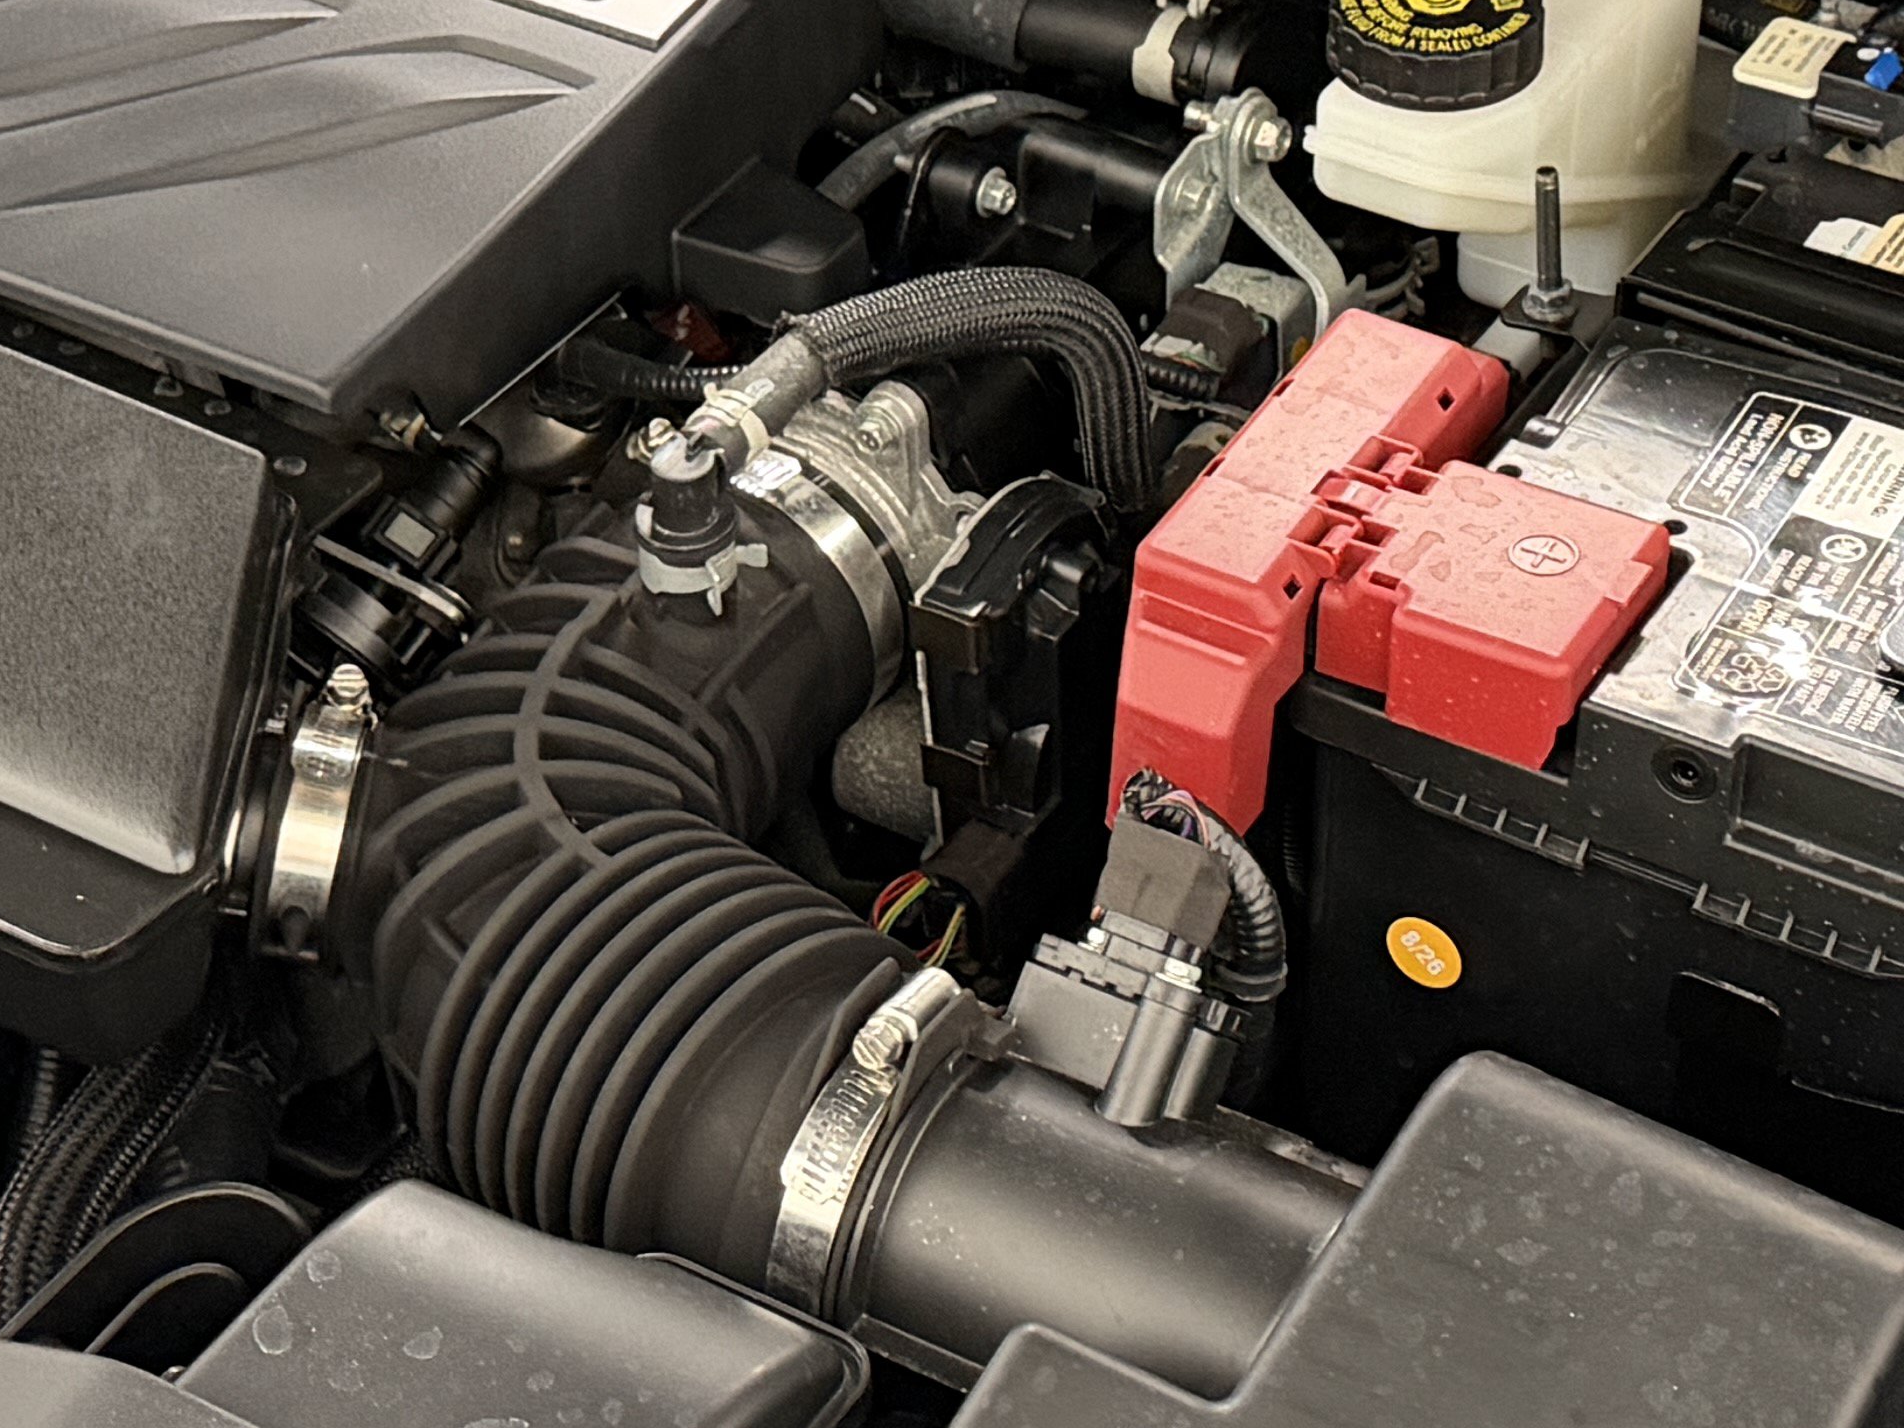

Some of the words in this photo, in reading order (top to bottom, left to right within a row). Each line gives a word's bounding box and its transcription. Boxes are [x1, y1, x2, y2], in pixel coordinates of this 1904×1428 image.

[1405, 36, 1415, 49] A
[1419, 38, 1471, 52] SEALED
[1410, 23, 1483, 41] REMOVING
[1737, 412, 1765, 437] Lead
[1710, 411, 1786, 502] NON-SPILLABLE
[1399, 930, 1446, 976] 8/26
